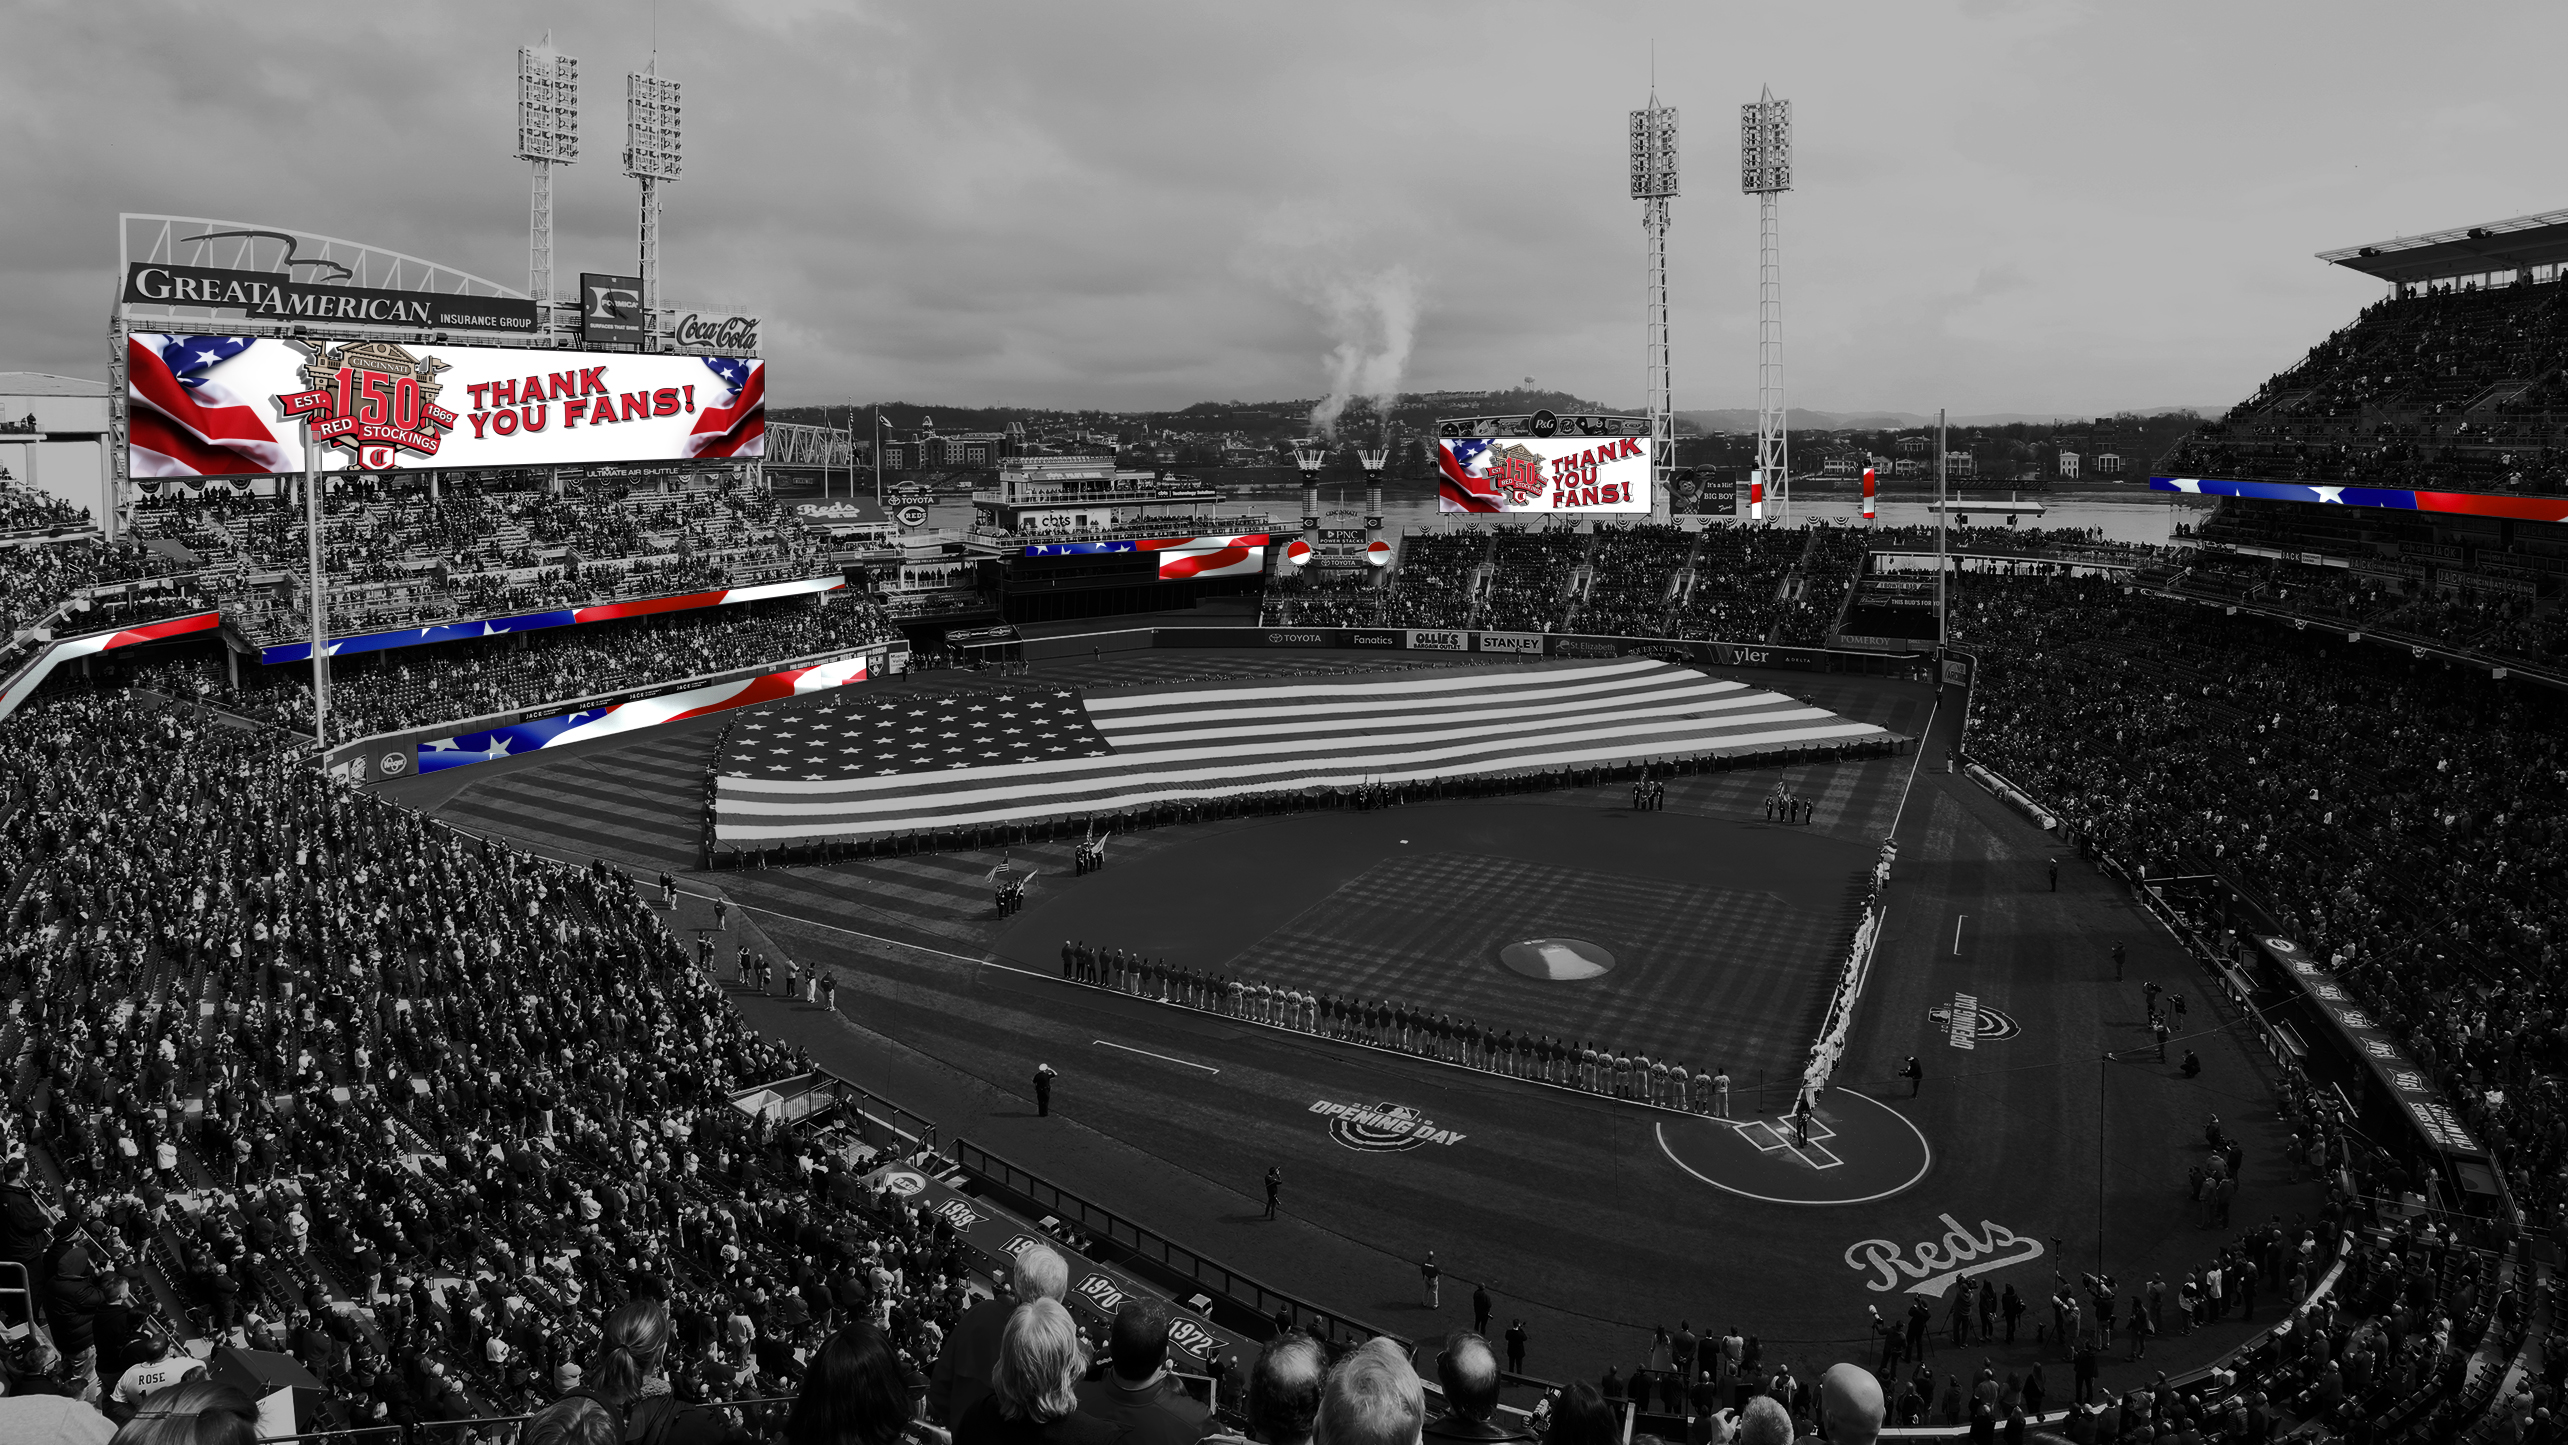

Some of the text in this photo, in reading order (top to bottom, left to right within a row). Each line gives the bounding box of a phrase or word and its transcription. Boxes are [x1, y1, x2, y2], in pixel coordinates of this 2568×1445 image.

[135, 268, 267, 304] GREAT
[440, 313, 532, 328] INSURANCE GROUP
[676, 313, 762, 350] Coca-Cola
[352, 357, 409, 374] CINCINNATI
[467, 366, 608, 411] THANK
[335, 367, 420, 430] 150
[294, 393, 453, 423] EST. 1869
[467, 385, 696, 440] YOU FANS!
[1535, 419, 1554, 429] P&G
[320, 418, 438, 450] RED STOCKINGS
[1552, 437, 1644, 474] THANK
[586, 467, 679, 477] ULTIMATE AIR SHUTTLE
[1506, 457, 1535, 485] 150
[1552, 467, 1599, 491] YOU
[1515, 482, 1542, 495] STOCKINGS
[1553, 481, 1632, 508] FANS!
[797, 501, 860, 518] Reds
[905, 512, 927, 520] REDS
[1336, 530, 1358, 539] PNC
[2282, 551, 2300, 561] JACK
[2433, 546, 2457, 557] JACK
[2351, 558, 2373, 570] JACK
[2404, 567, 2424, 576] CASINO
[2439, 571, 2534, 594] JACK CINCINNATI CASINO
[1284, 634, 1322, 642] TOYOTA
[1353, 634, 1393, 645] Fanatics
[1484, 637, 1539, 648] STANLEY
[1580, 641, 1616, 651] Elizabeth
[1841, 635, 1890, 646] POMEROY
[1706, 643, 1769, 665] Wyler
[629, 692, 644, 700] JACK
[579, 702, 595, 710] JACK
[525, 712, 543, 720] JACK
[1949, 991, 1978, 1051] OPENING DAY
[1308, 1100, 1467, 1146] OPENING DAY
[895, 1177, 921, 1194] REDS
[938, 1200, 976, 1228] 1939
[1006, 1237, 1034, 1253] 19
[1845, 1212, 2045, 1298] Reds
[1080, 1276, 1124, 1309] 1970
[1168, 1320, 1213, 1355] 1972
[138, 1372, 166, 1385] ROSE
